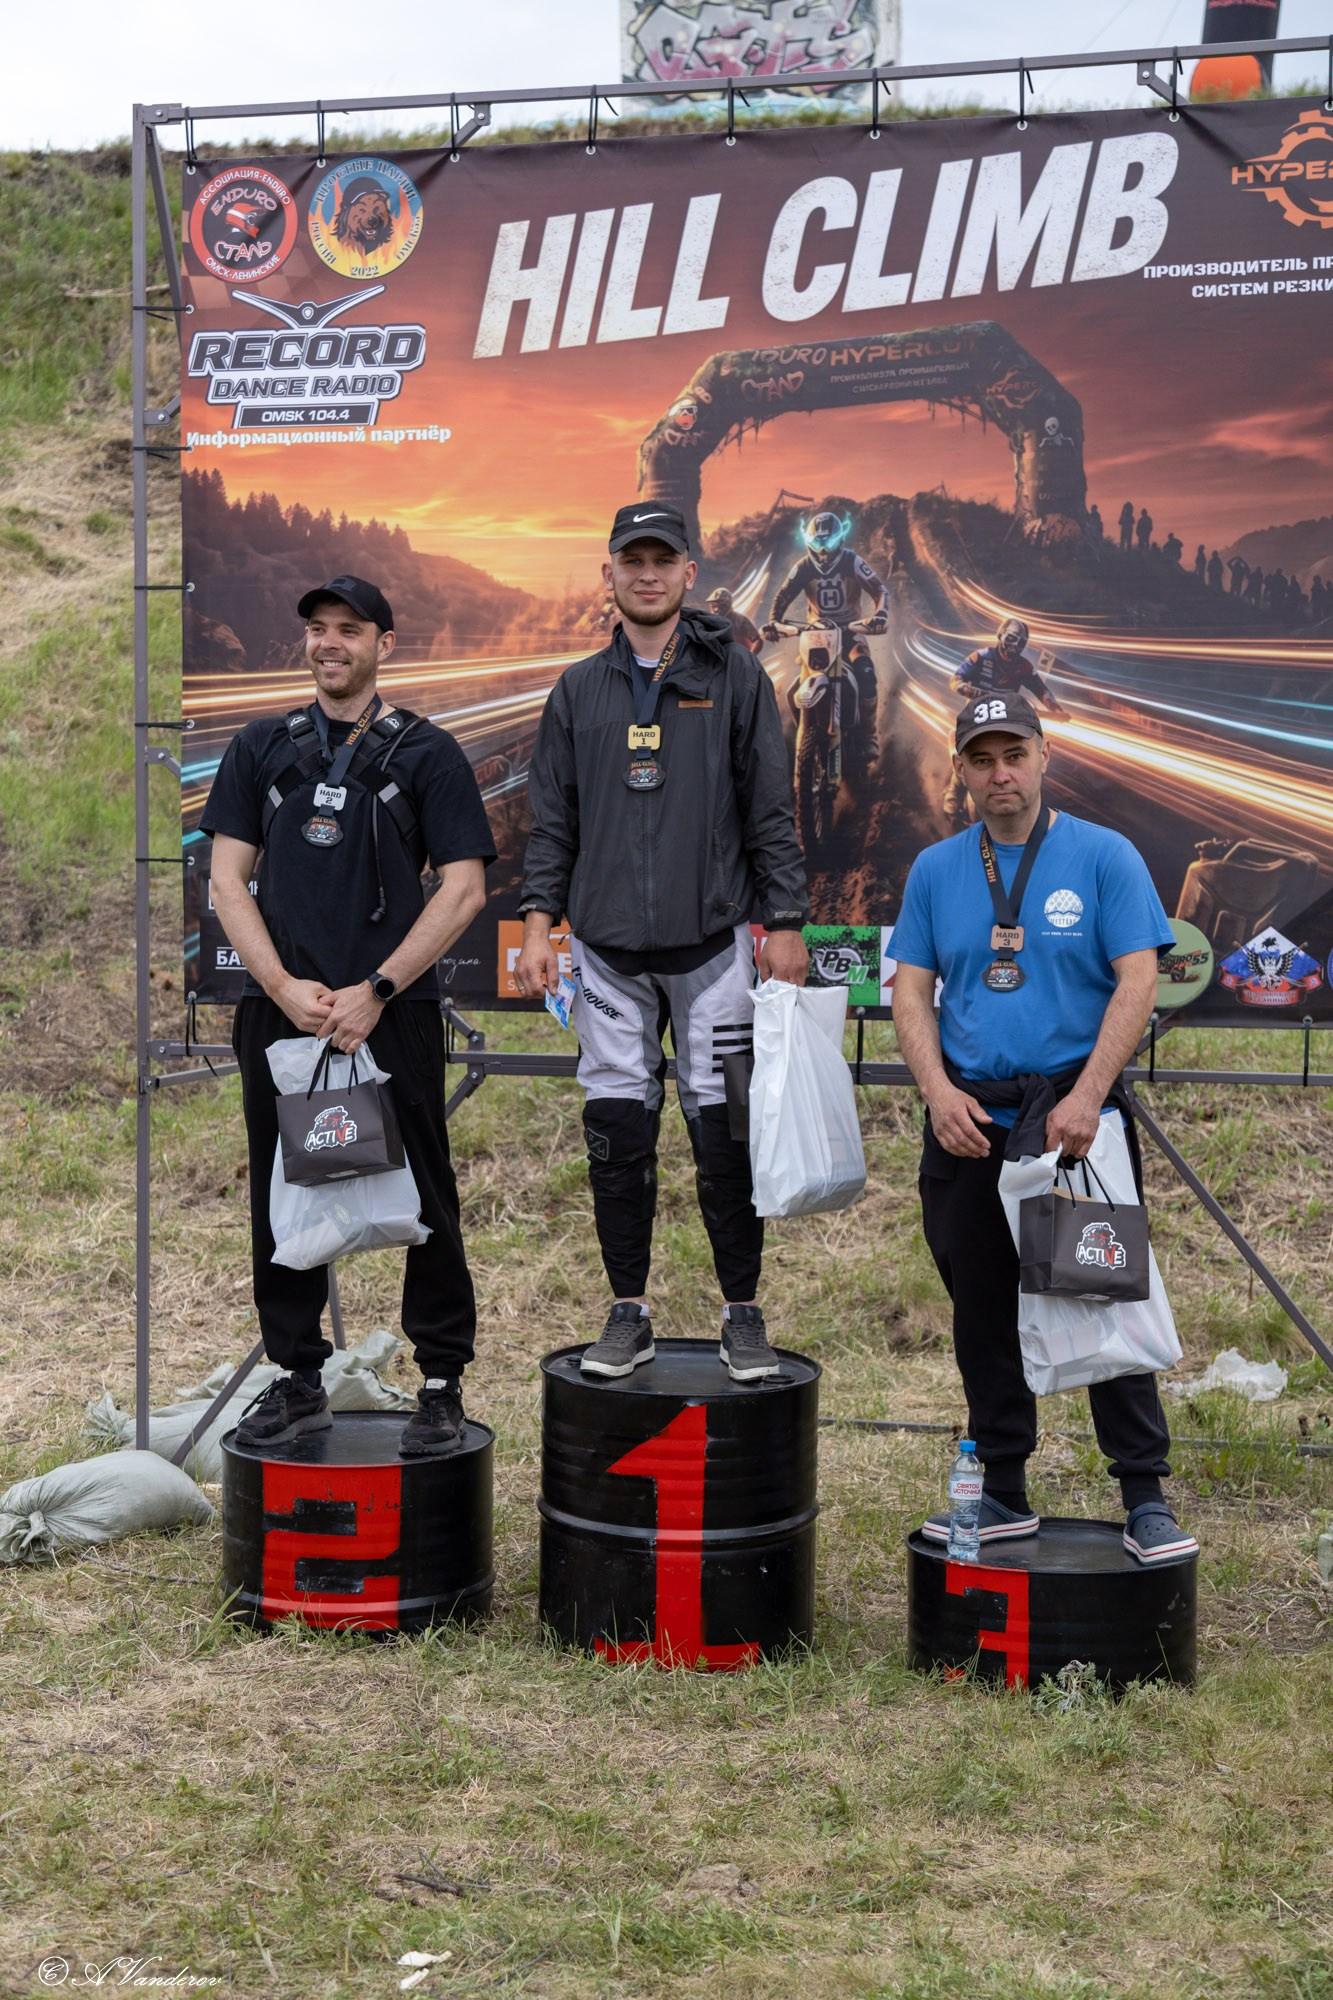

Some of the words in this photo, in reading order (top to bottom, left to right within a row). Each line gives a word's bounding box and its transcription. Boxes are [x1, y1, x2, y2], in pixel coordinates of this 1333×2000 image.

[210, 187, 278, 216] ENDURO
[473, 193, 730, 359] HILL
[762, 132, 1179, 323] CLIMB
[351, 265, 379, 276] 2022
[1143, 258, 1308, 278] ПРОИЗВОДИТЕЛЬ
[1192, 281, 1268, 298] СИСТЕМ
[189, 328, 425, 373] RECORD
[211, 376, 309, 399] DANCE
[310, 374, 398, 397] RADIO
[261, 410, 305, 423] OMSK
[308, 409, 350, 421] 104.4
[186, 427, 366, 448] Информационный
[371, 425, 451, 443] партнёр
[653, 661, 667, 681] HILL
[974, 700, 1007, 724] 32
[346, 728, 362, 745] HILL
[319, 789, 341, 799] HARD
[985, 859, 996, 883] HILL
[216, 950, 245, 967] БА
[306, 1122, 355, 1148] ACTIVE
[1077, 1245, 1123, 1265] ACTIVE
[262, 1460, 401, 1631] 2
[594, 1405, 759, 1673] 1
